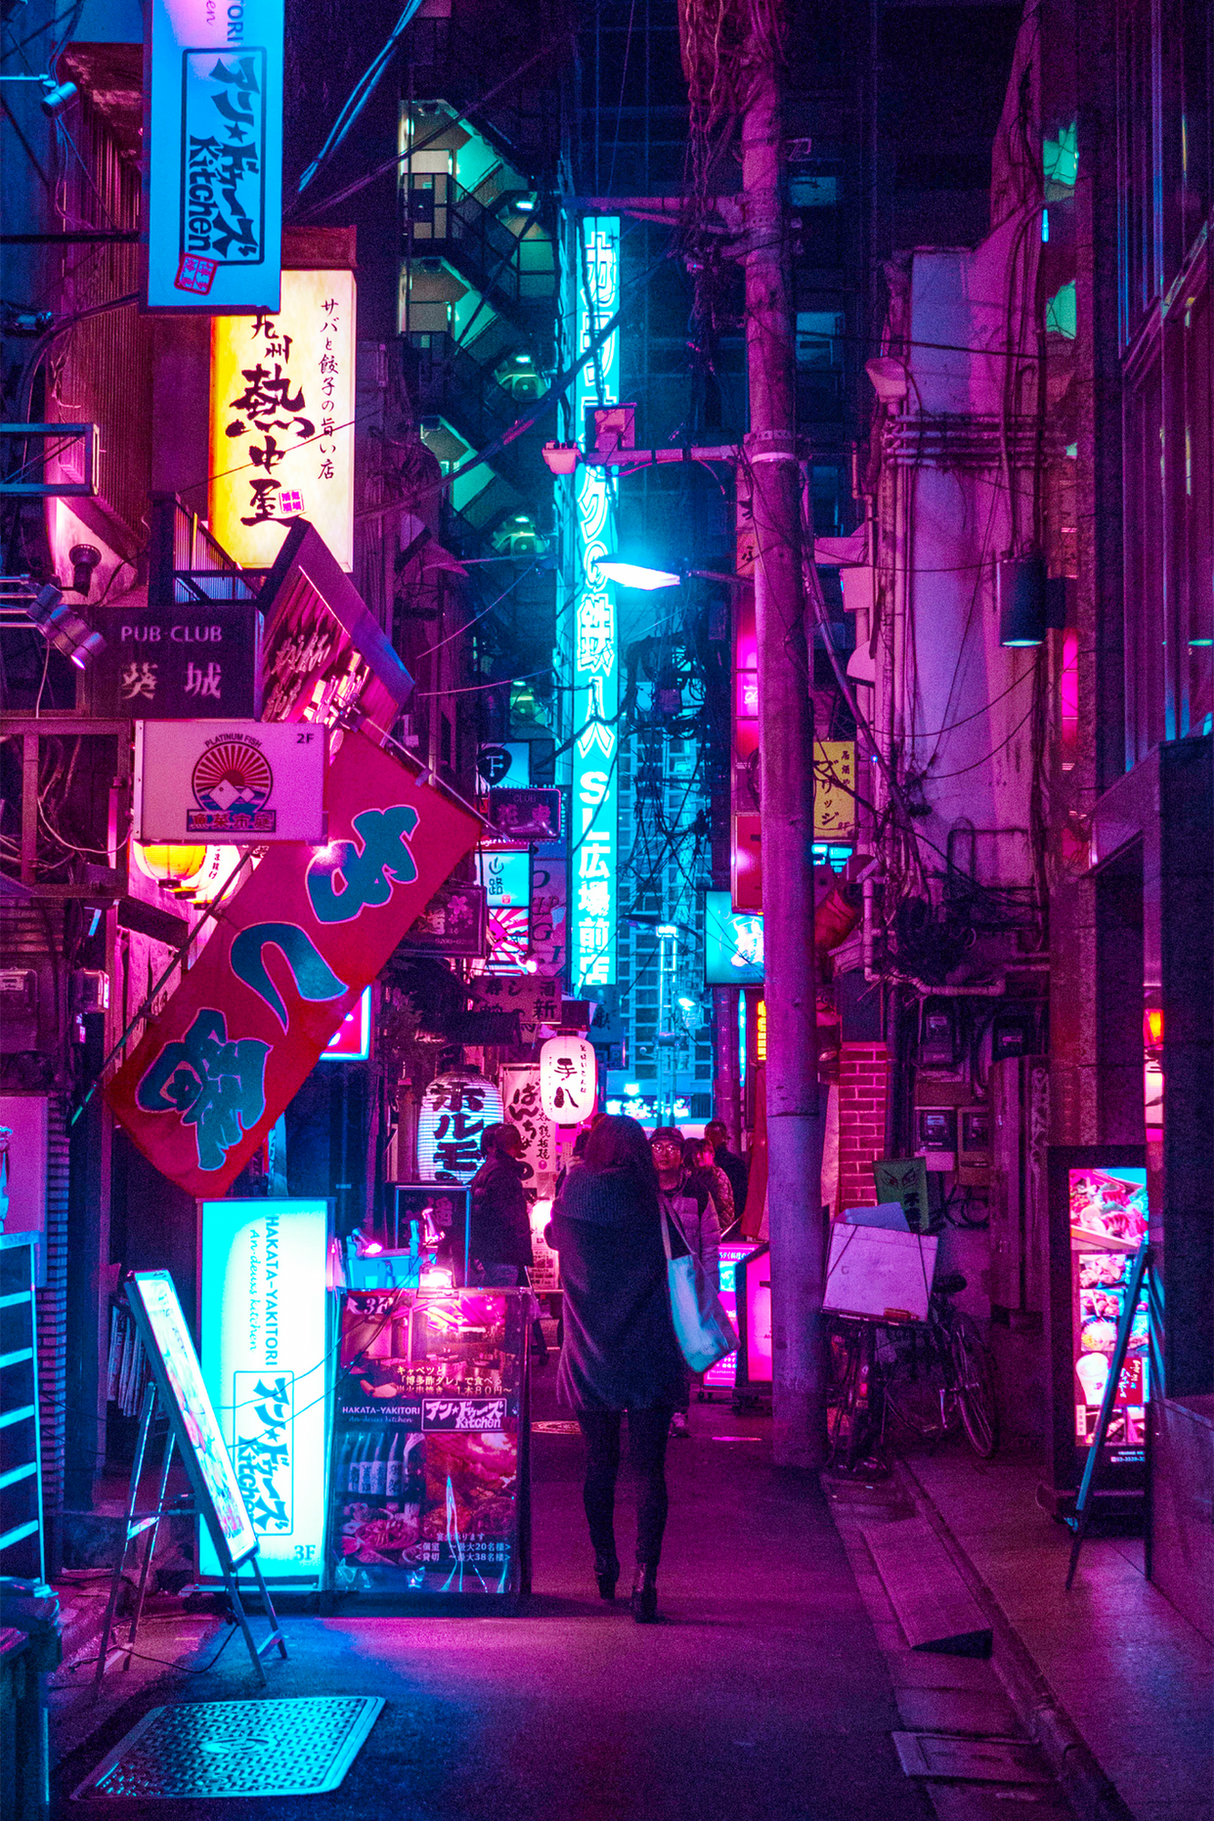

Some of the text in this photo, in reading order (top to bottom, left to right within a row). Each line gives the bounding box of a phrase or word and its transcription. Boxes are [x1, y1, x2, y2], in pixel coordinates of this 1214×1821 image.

[188, 135, 222, 251] Kitchen
[317, 298, 340, 480] サバと餃子の旨い店
[204, 733, 262, 749] PLATINUM FISH
[296, 733, 314, 744] 2F
[264, 1215, 280, 1367] HAKATA-YAKITORI
[249, 1298, 260, 1352] kitchen
[342, 1405, 421, 1415] HAKATA-YAKITORI
[454, 1416, 502, 1430] Kitchen
[294, 1544, 316, 1561] 3F
